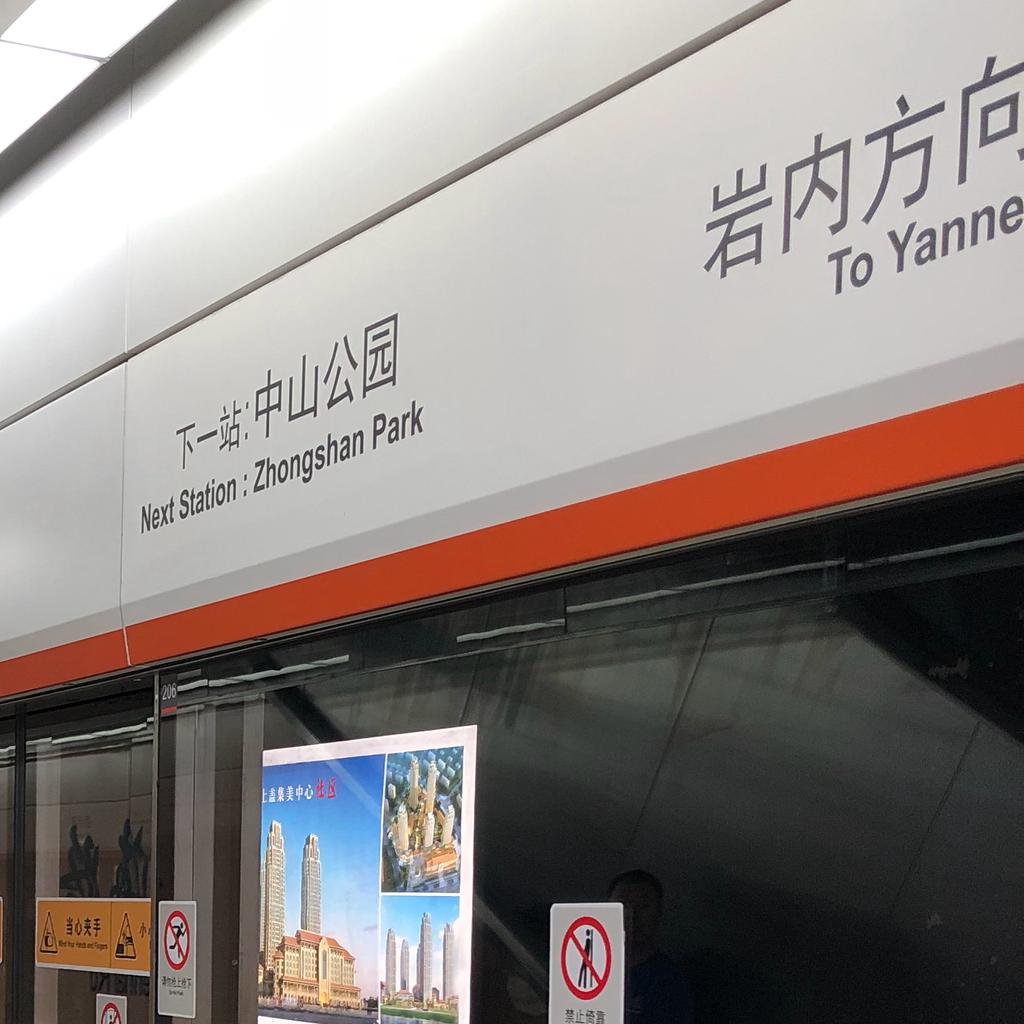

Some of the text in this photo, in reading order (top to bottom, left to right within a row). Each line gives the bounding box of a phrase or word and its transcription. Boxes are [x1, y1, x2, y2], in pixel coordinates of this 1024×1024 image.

[703, 56, 1024, 279] 岩内方向
[828, 246, 874, 295] To
[141, 495, 174, 534] Next
[179, 474, 237, 520] Station
[253, 430, 364, 494] Zhongshan
[372, 400, 424, 450] Park
[66, 916, 102, 937] 当心夹手
